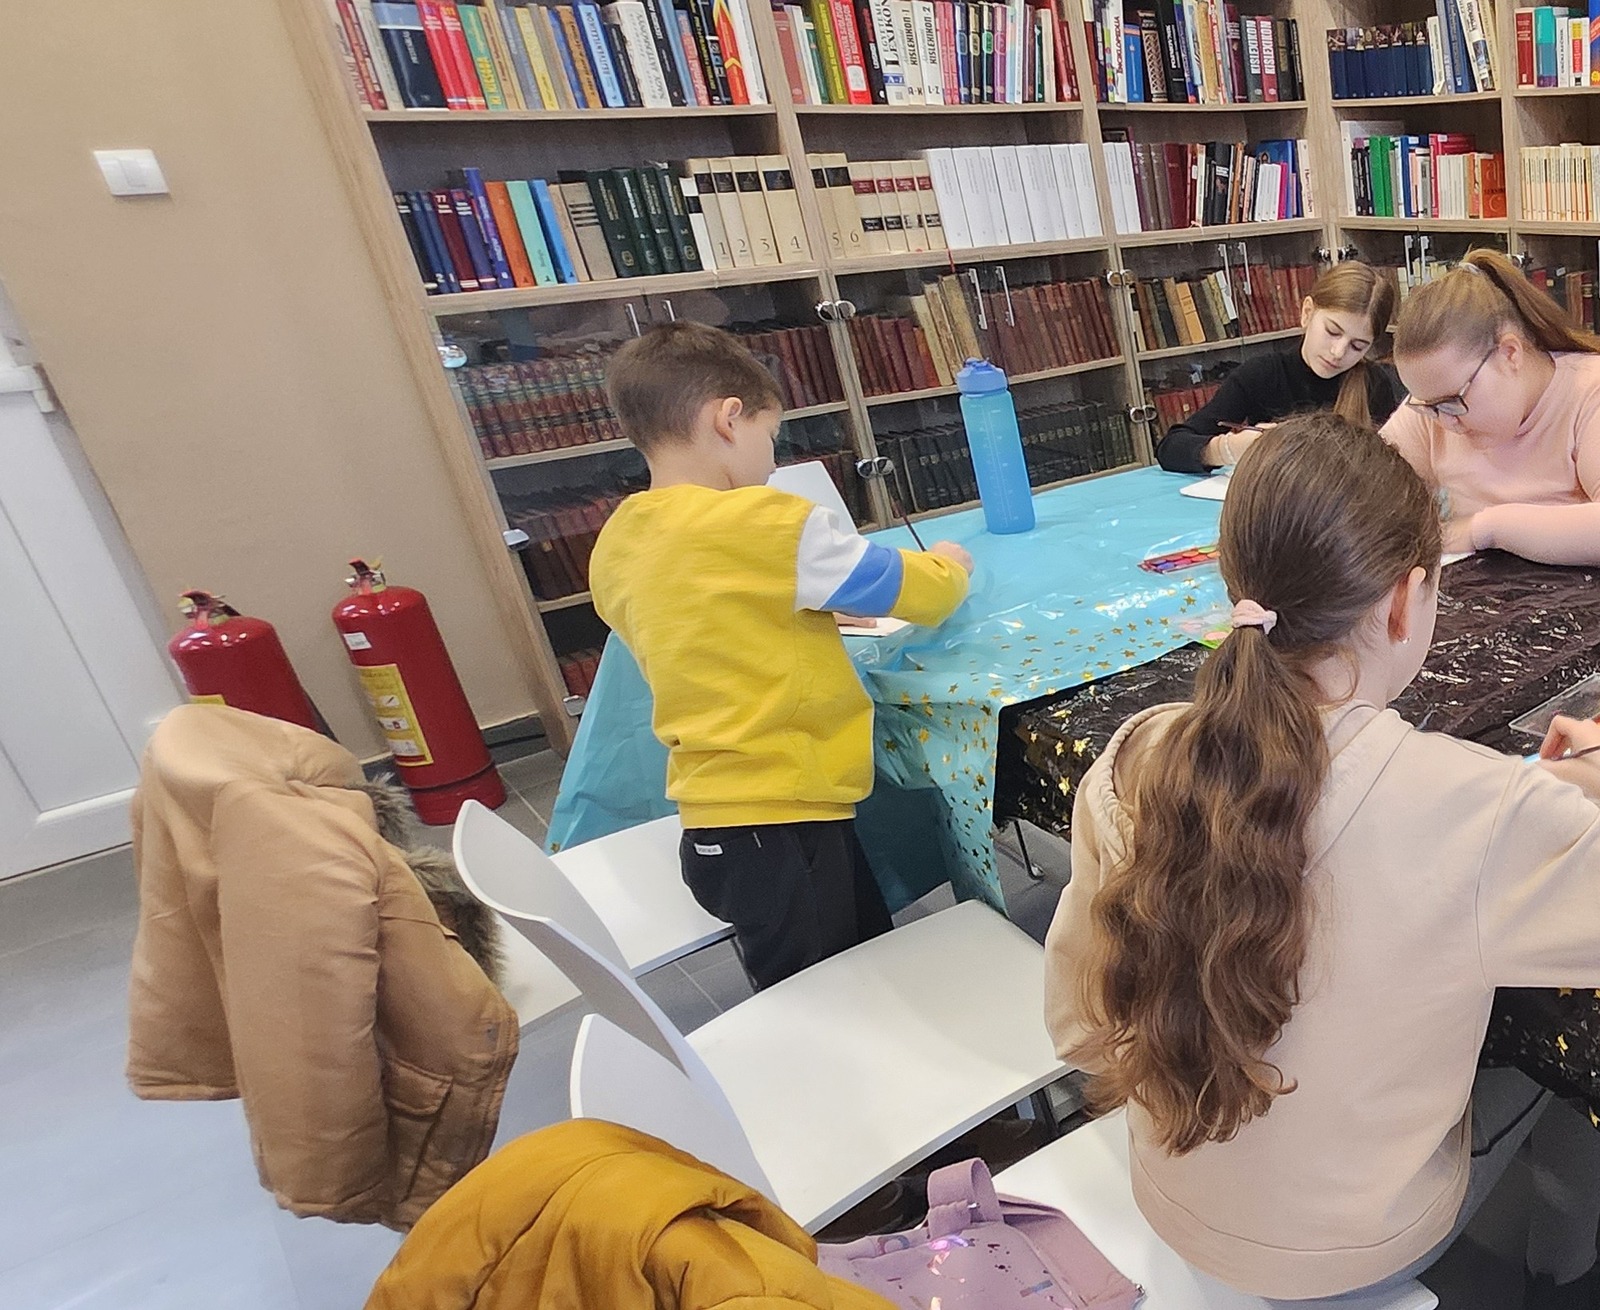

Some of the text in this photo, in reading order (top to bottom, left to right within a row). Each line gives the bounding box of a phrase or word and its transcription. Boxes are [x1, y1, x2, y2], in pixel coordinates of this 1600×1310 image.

[881, 0, 900, 67] LEXIKON
[903, 16, 918, 66] KISLEXIKON
[924, 16, 938, 65] KISLEXIKON
[1246, 20, 1261, 75] KISLEXIKON
[1260, 20, 1276, 75] KISLEXIKON
[654, 75, 666, 100] NAGY
[760, 238, 770, 251] 3
[790, 236, 801, 250] 4
[832, 232, 840, 246] 5
[850, 231, 859, 243] 6
[719, 242, 727, 255] 1
[738, 238, 747, 253] 2
[435, 272, 446, 283] 2
